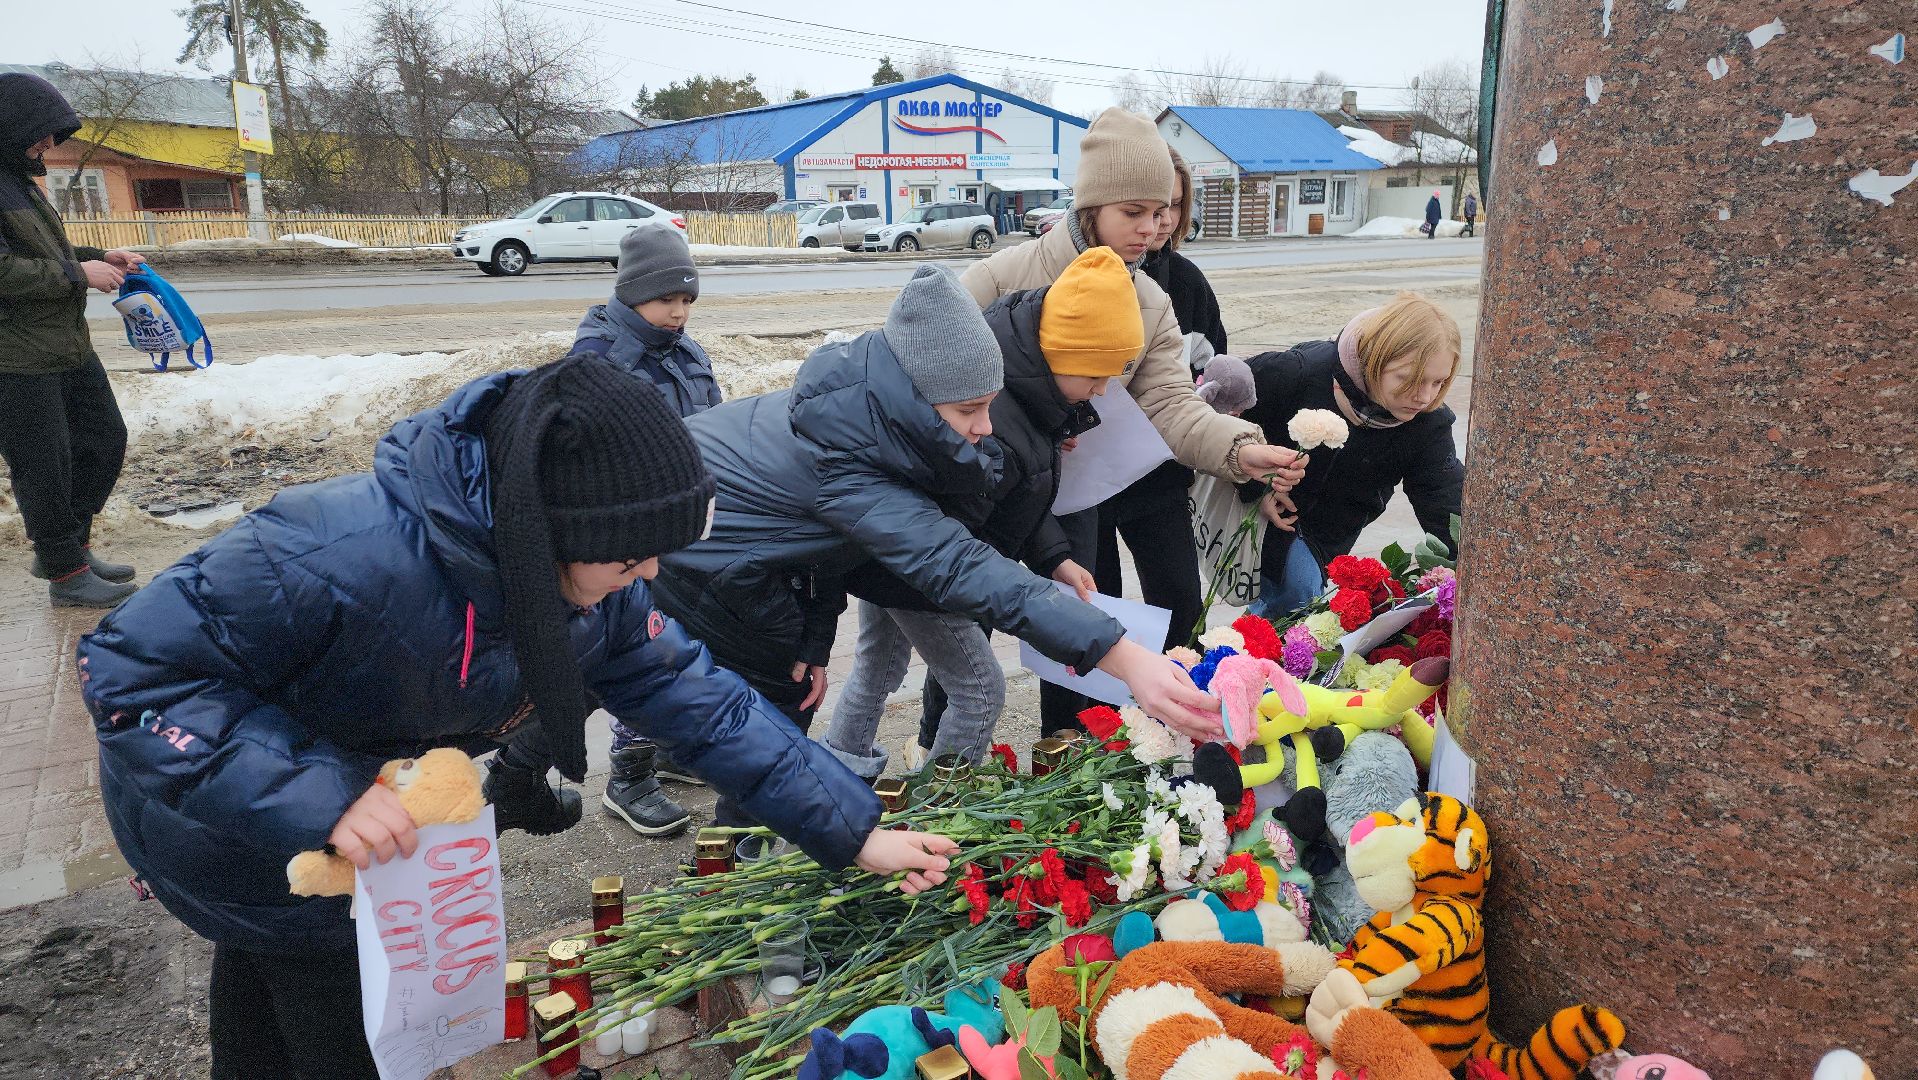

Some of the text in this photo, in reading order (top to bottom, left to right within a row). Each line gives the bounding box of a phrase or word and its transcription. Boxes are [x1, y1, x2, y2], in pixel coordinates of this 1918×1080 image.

[898, 99, 1003, 118] АКВА МАСТЕР
[857, 156, 964, 168] НЕДОРОГАЯ-МЕБЕЛЬ.РФ
[134, 320, 173, 338] SMILE
[424, 837, 501, 995] CROCUS
[378, 900, 429, 972] CITY
